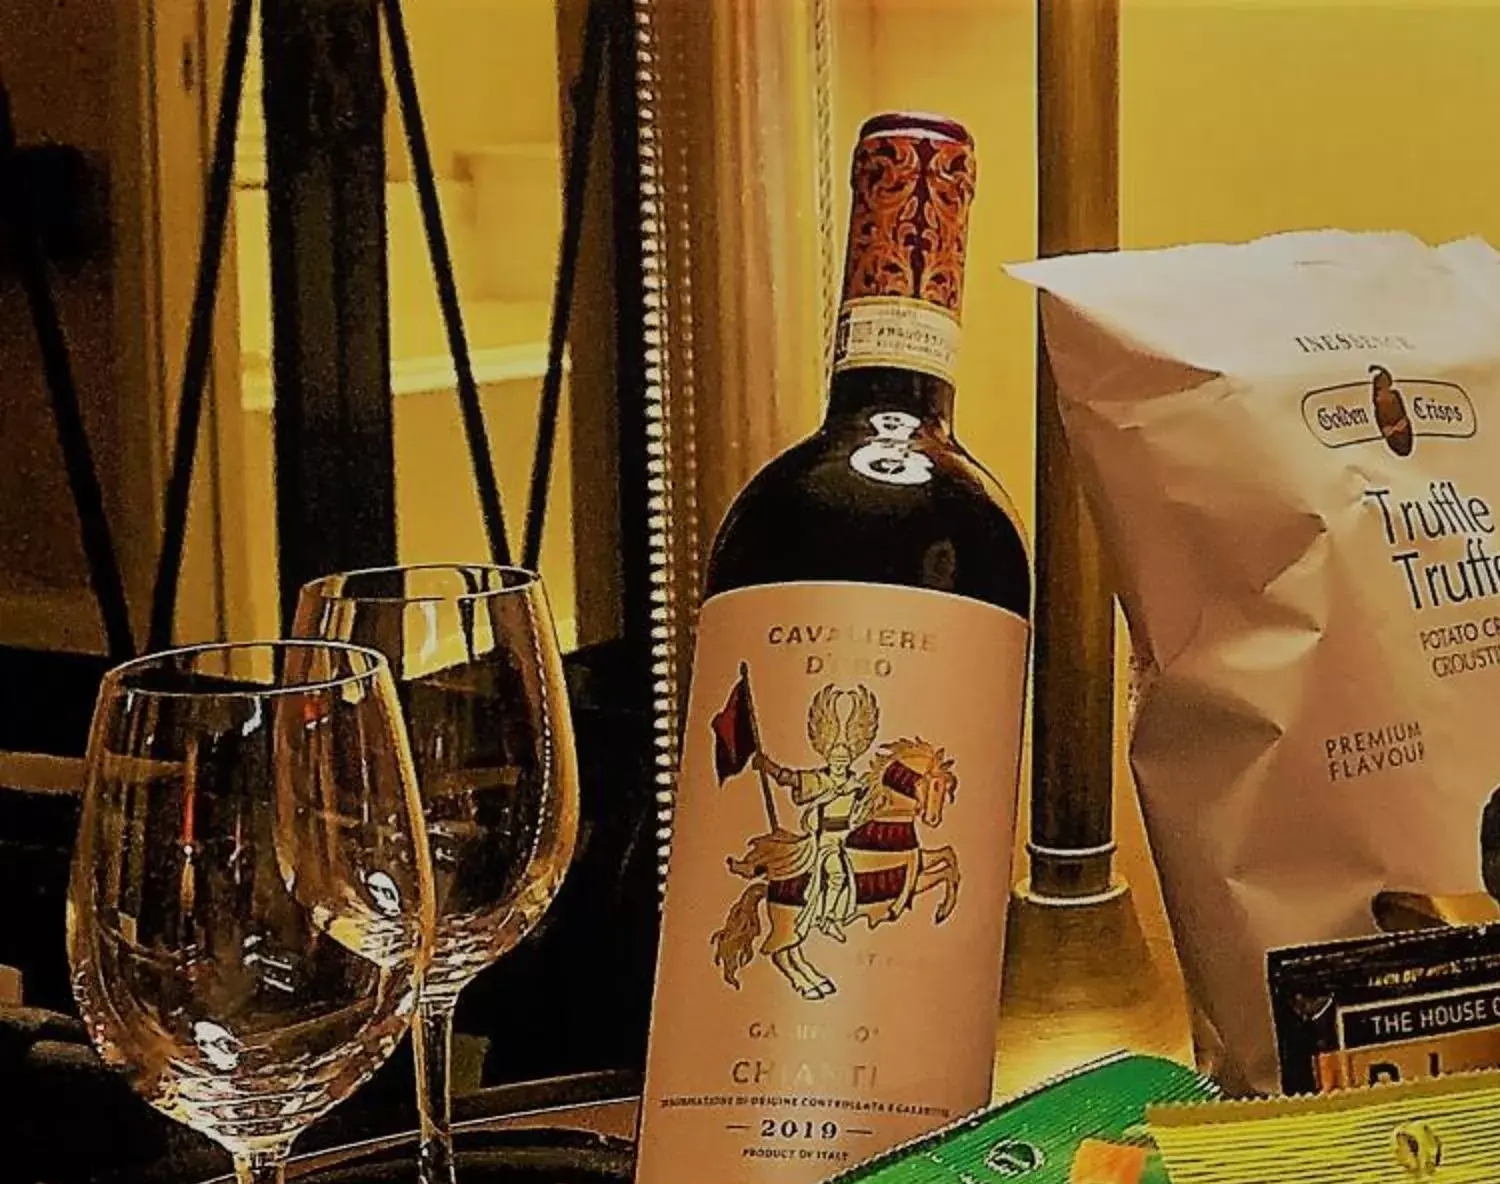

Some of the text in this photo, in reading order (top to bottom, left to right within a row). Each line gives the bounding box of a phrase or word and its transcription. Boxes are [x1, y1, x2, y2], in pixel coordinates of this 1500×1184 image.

[1317, 397, 1462, 430] Golden Crisps
[1364, 481, 1495, 545] Truffle
[1419, 622, 1479, 651] POTATO
[805, 651, 893, 678] D'O
[1325, 721, 1423, 759] PREMIUM
[1370, 1009, 1414, 1036] THE
[1419, 999, 1488, 1030] HOUSE
[760, 1119, 838, 1140] 2019
[741, 1149, 850, 1162] PRODUCT OF ITALY
